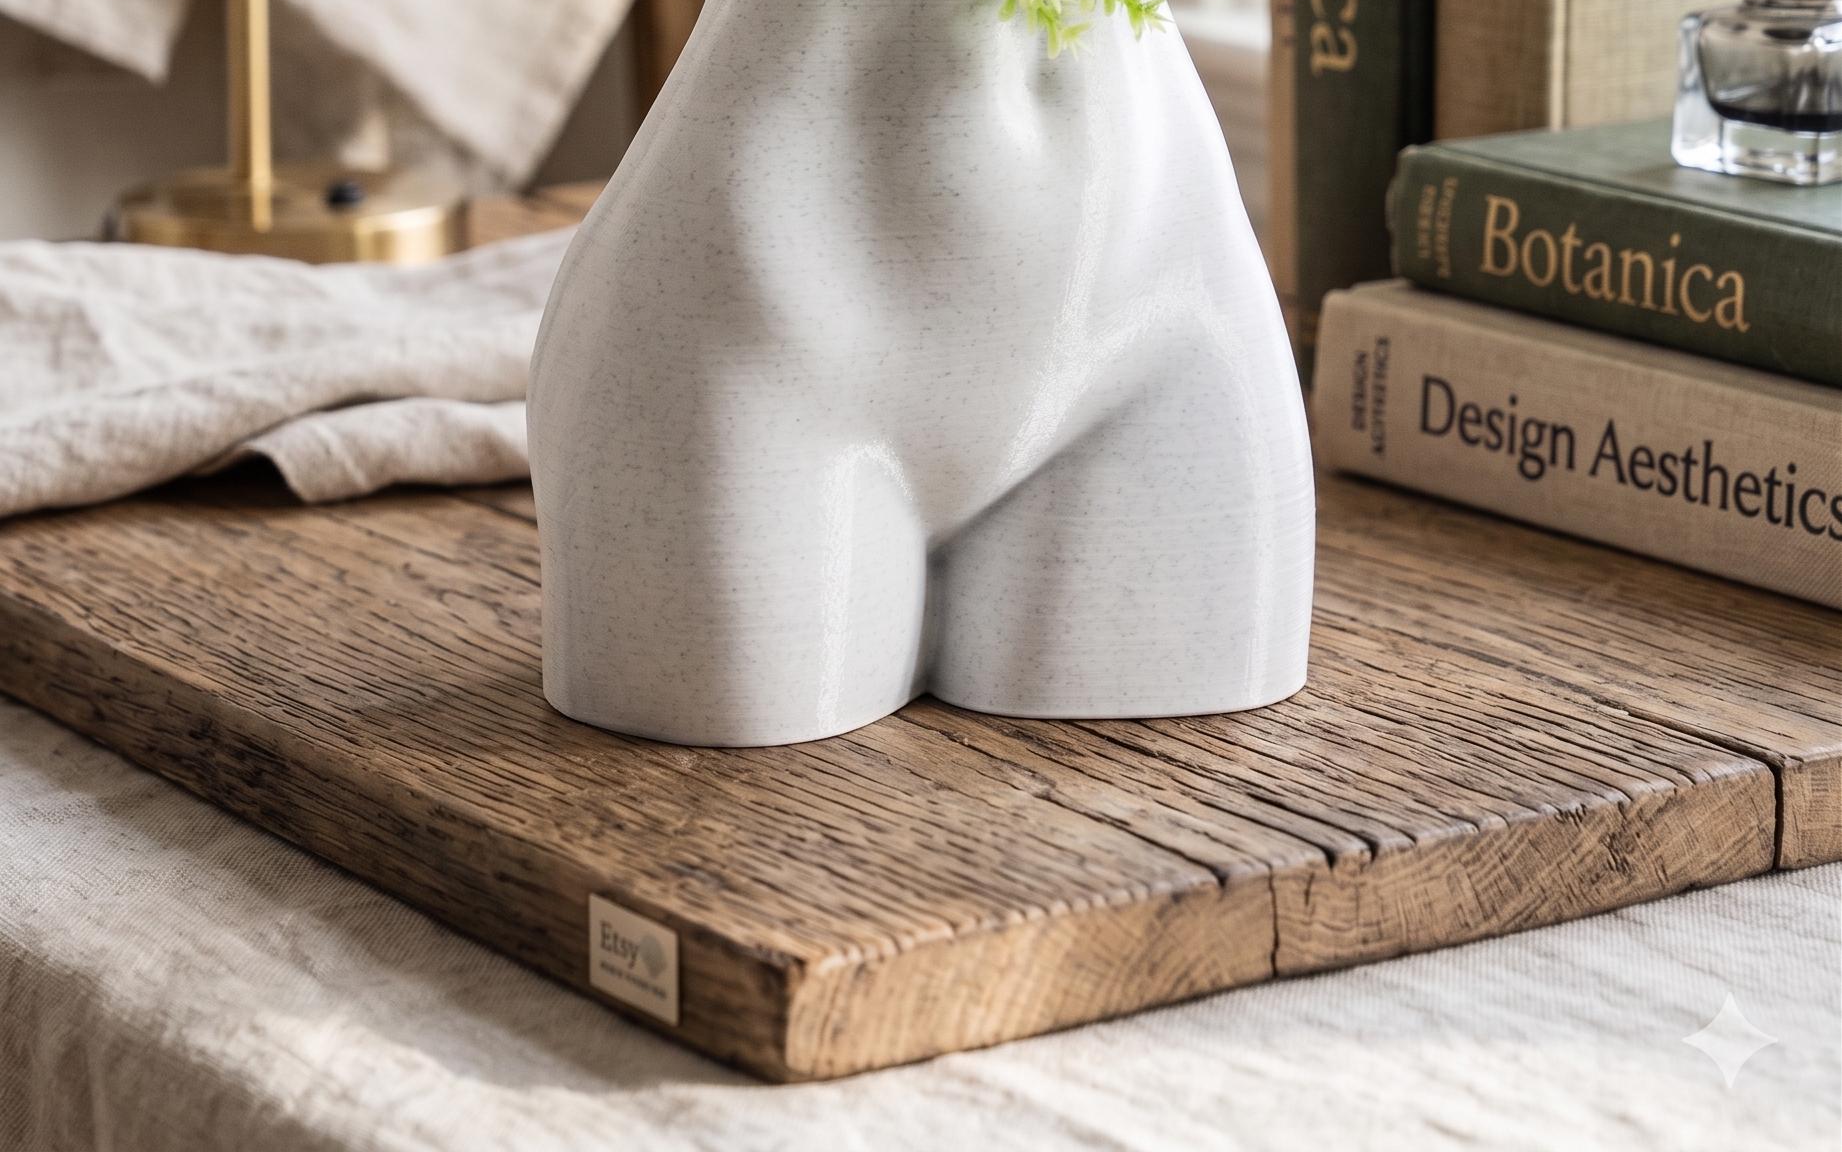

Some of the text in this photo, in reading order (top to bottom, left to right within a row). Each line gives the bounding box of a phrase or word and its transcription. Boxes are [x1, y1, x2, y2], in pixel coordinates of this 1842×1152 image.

[1480, 195, 1750, 333] Botanica
[1419, 374, 1842, 543] Design Aesthetics
[600, 920, 640, 970] Etsy
